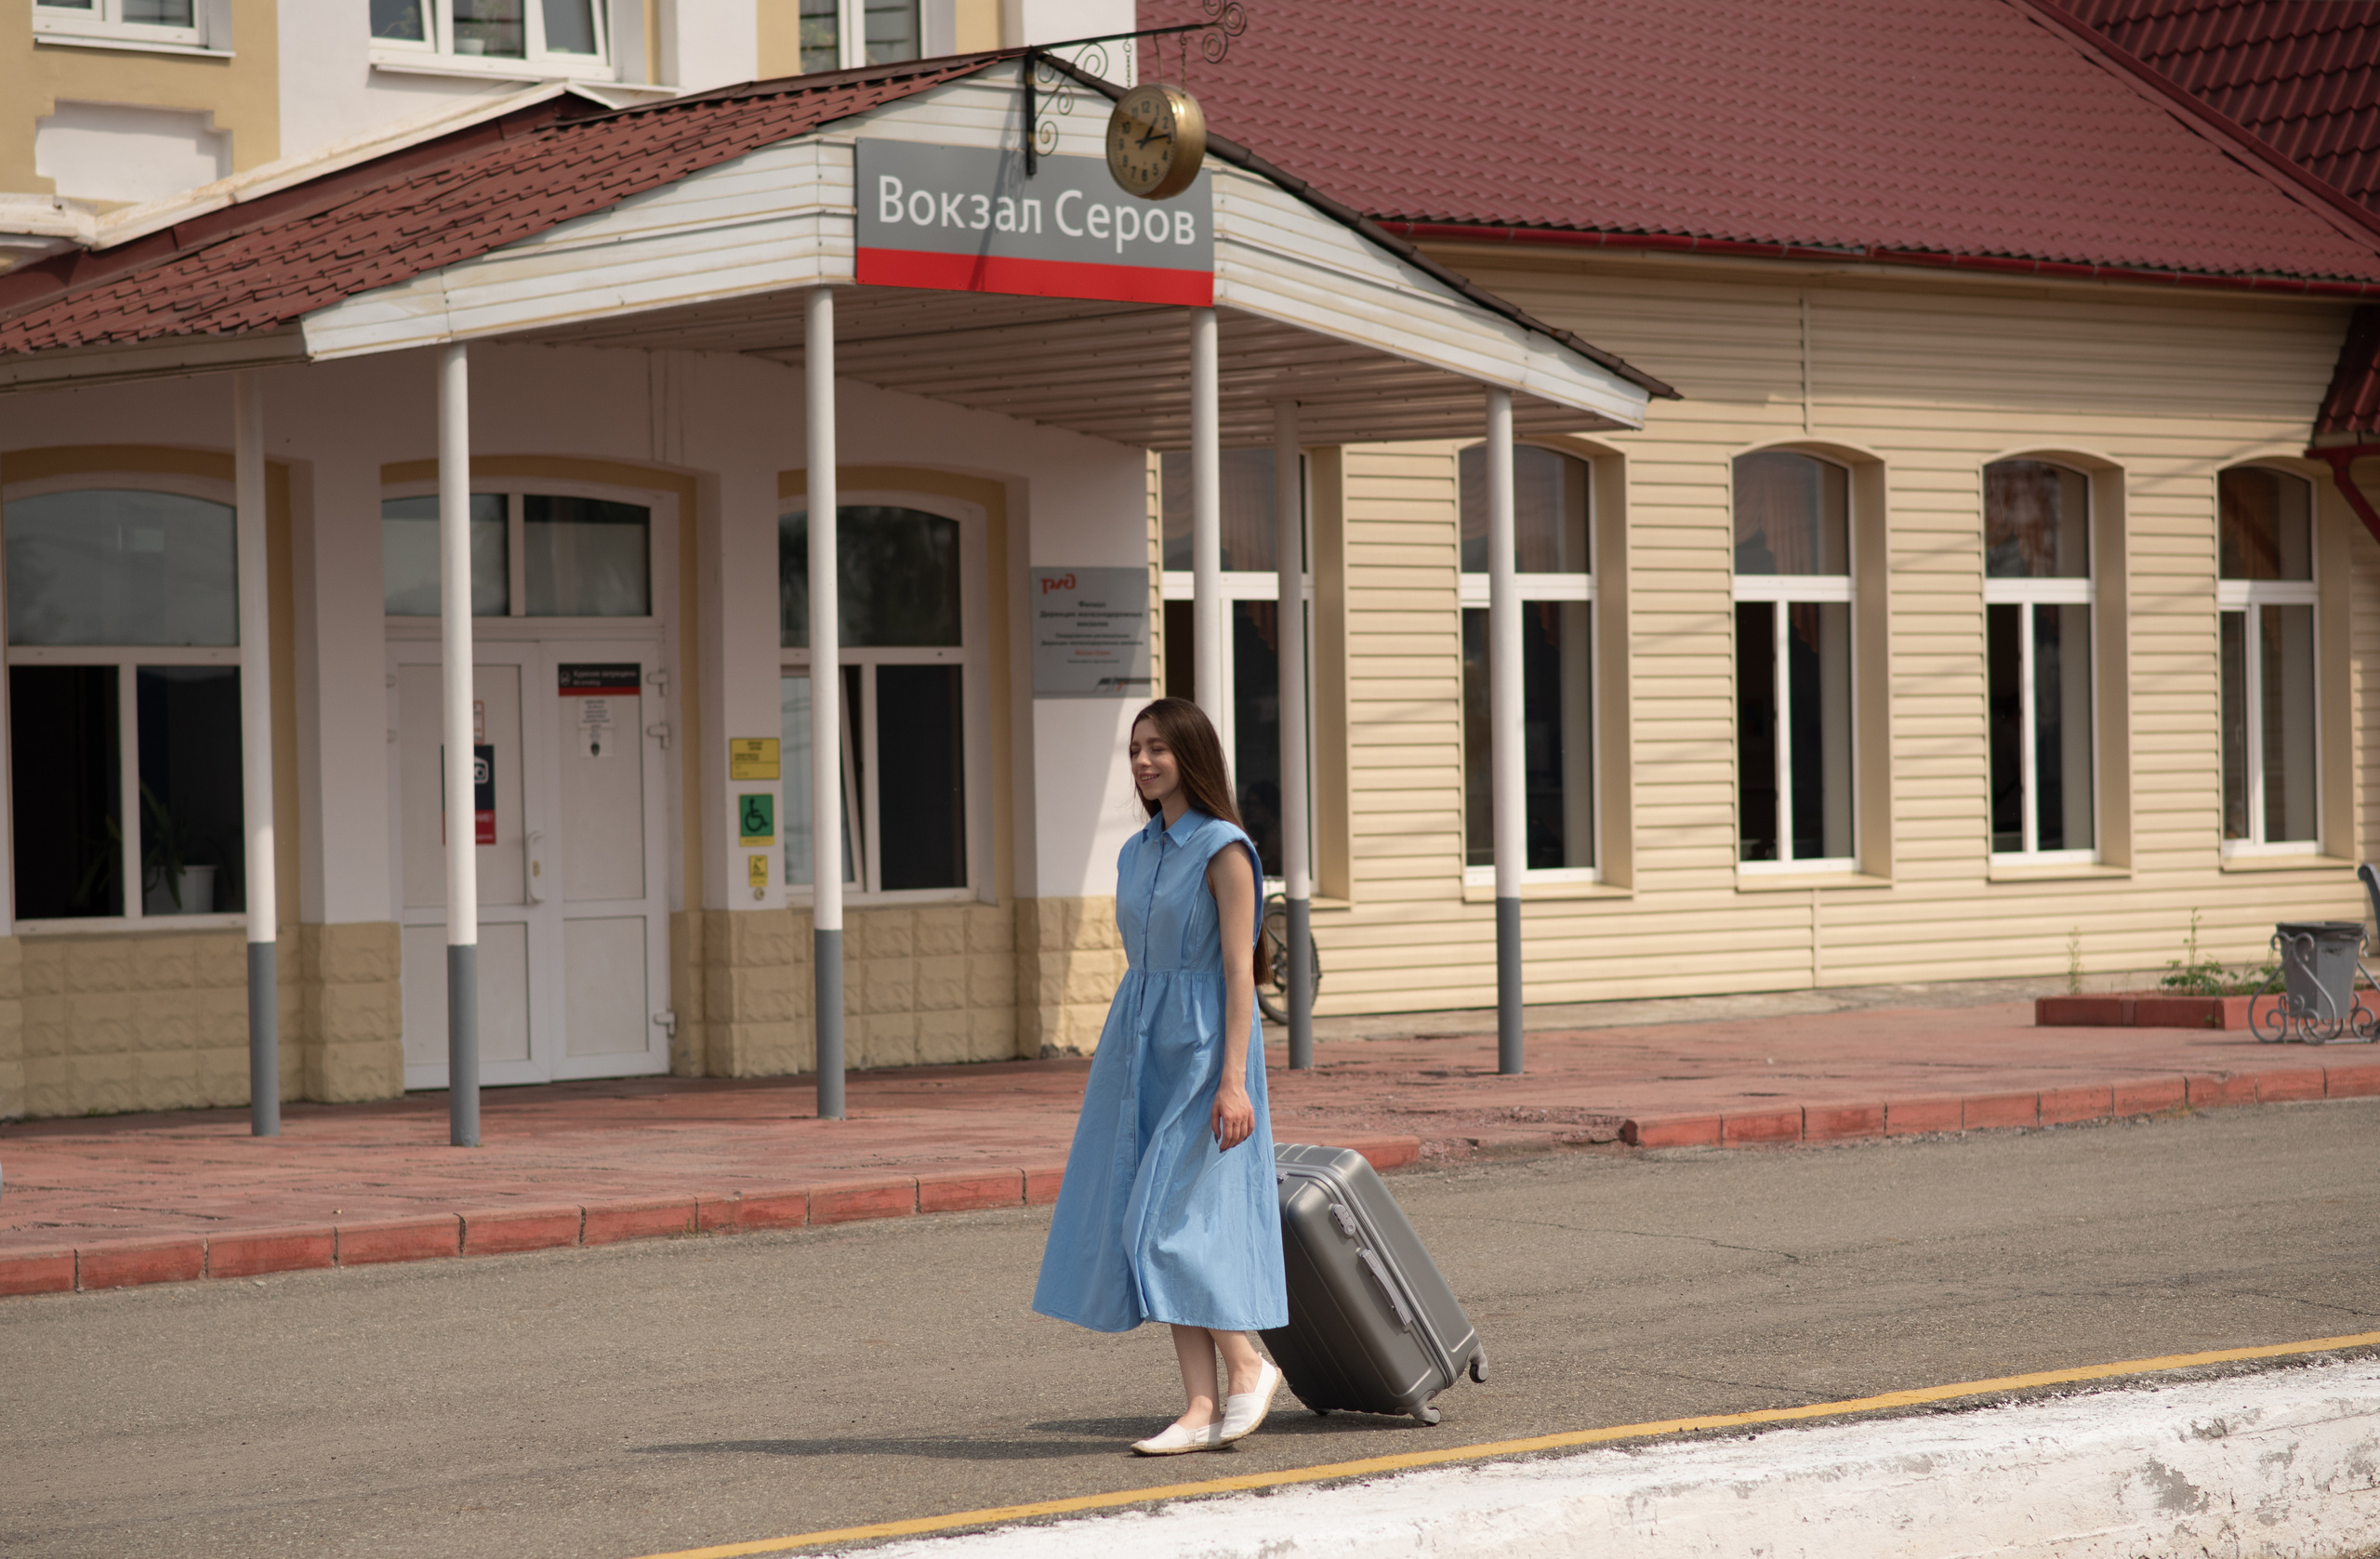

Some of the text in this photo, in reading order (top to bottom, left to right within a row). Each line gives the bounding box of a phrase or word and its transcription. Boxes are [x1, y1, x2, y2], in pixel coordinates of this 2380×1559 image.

[1131, 107, 1139, 119] 11
[1141, 100, 1151, 113] 12
[1156, 103, 1160, 115] 1
[1122, 121, 1131, 134] 10
[1162, 116, 1169, 129] 2
[1118, 139, 1125, 151] 9
[1123, 154, 1129, 167] 8
[1161, 150, 1168, 161] 4
[1130, 165, 1137, 179] 7
[1142, 169, 1148, 181] 6
[1153, 163, 1159, 176] 5
[878, 175, 1197, 254] Вокзал Серов
